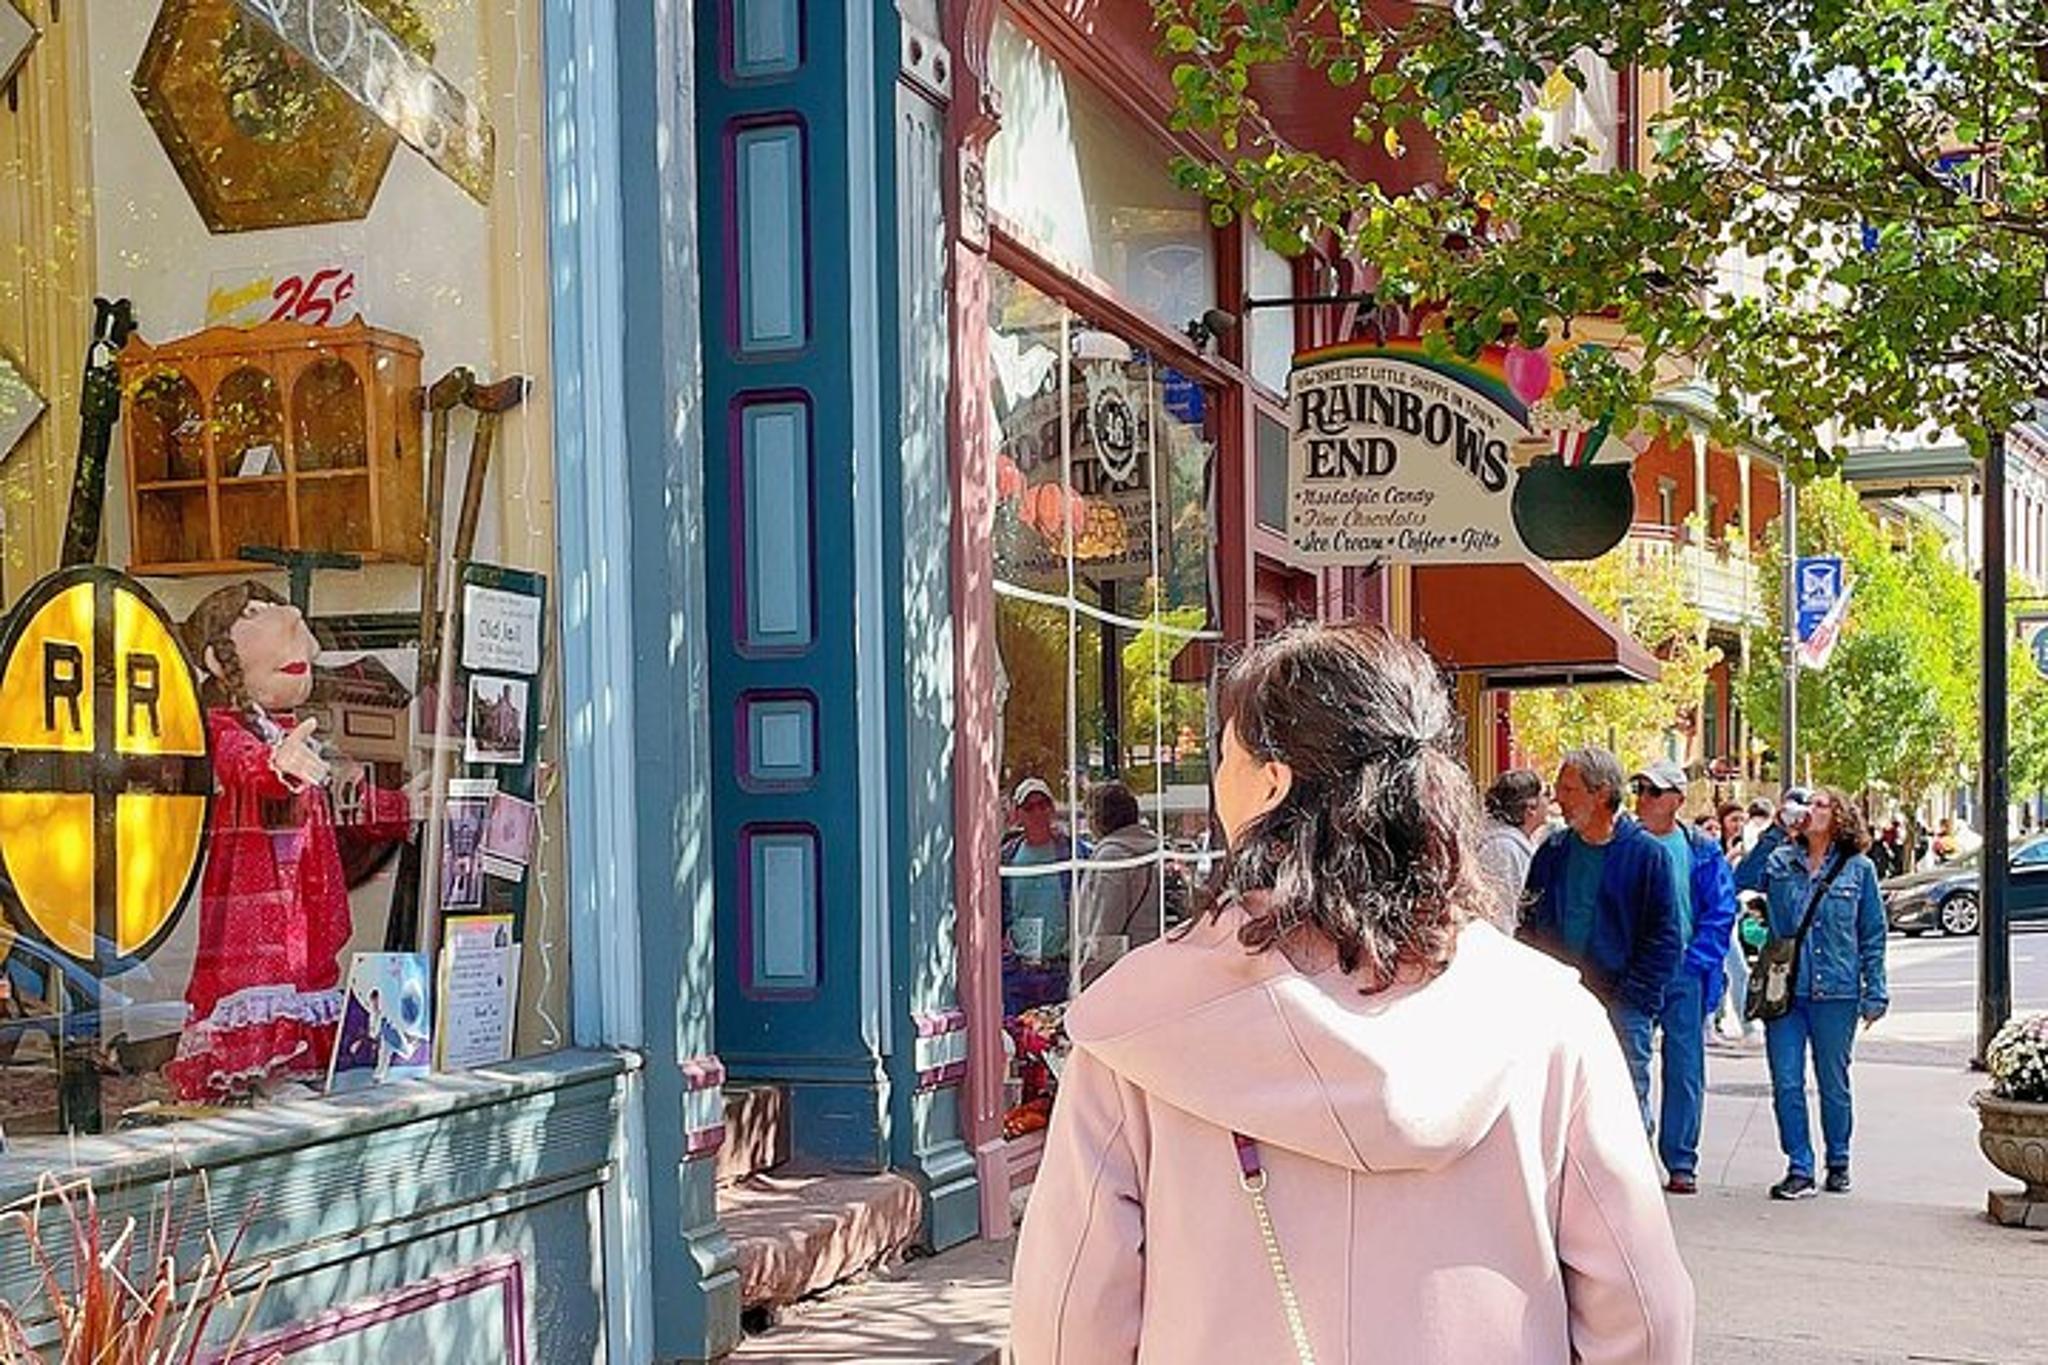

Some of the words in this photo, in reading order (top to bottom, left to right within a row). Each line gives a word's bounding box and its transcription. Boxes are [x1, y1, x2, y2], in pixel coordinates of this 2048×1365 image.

[1371, 368, 1406, 385] LITTLE
[1297, 383, 1508, 492] RAINBOWS
[1306, 437, 1398, 478] END
[1302, 488, 1380, 509] Nostalgic
[1384, 486, 1435, 507] Candy
[1303, 508, 1338, 527] Fine
[1342, 508, 1426, 528] Chocolates
[1300, 530, 1329, 552] Ice
[1333, 528, 1383, 552] Cream
[1399, 528, 1446, 554] Coffee
[1461, 527, 1501, 552] Gifts
